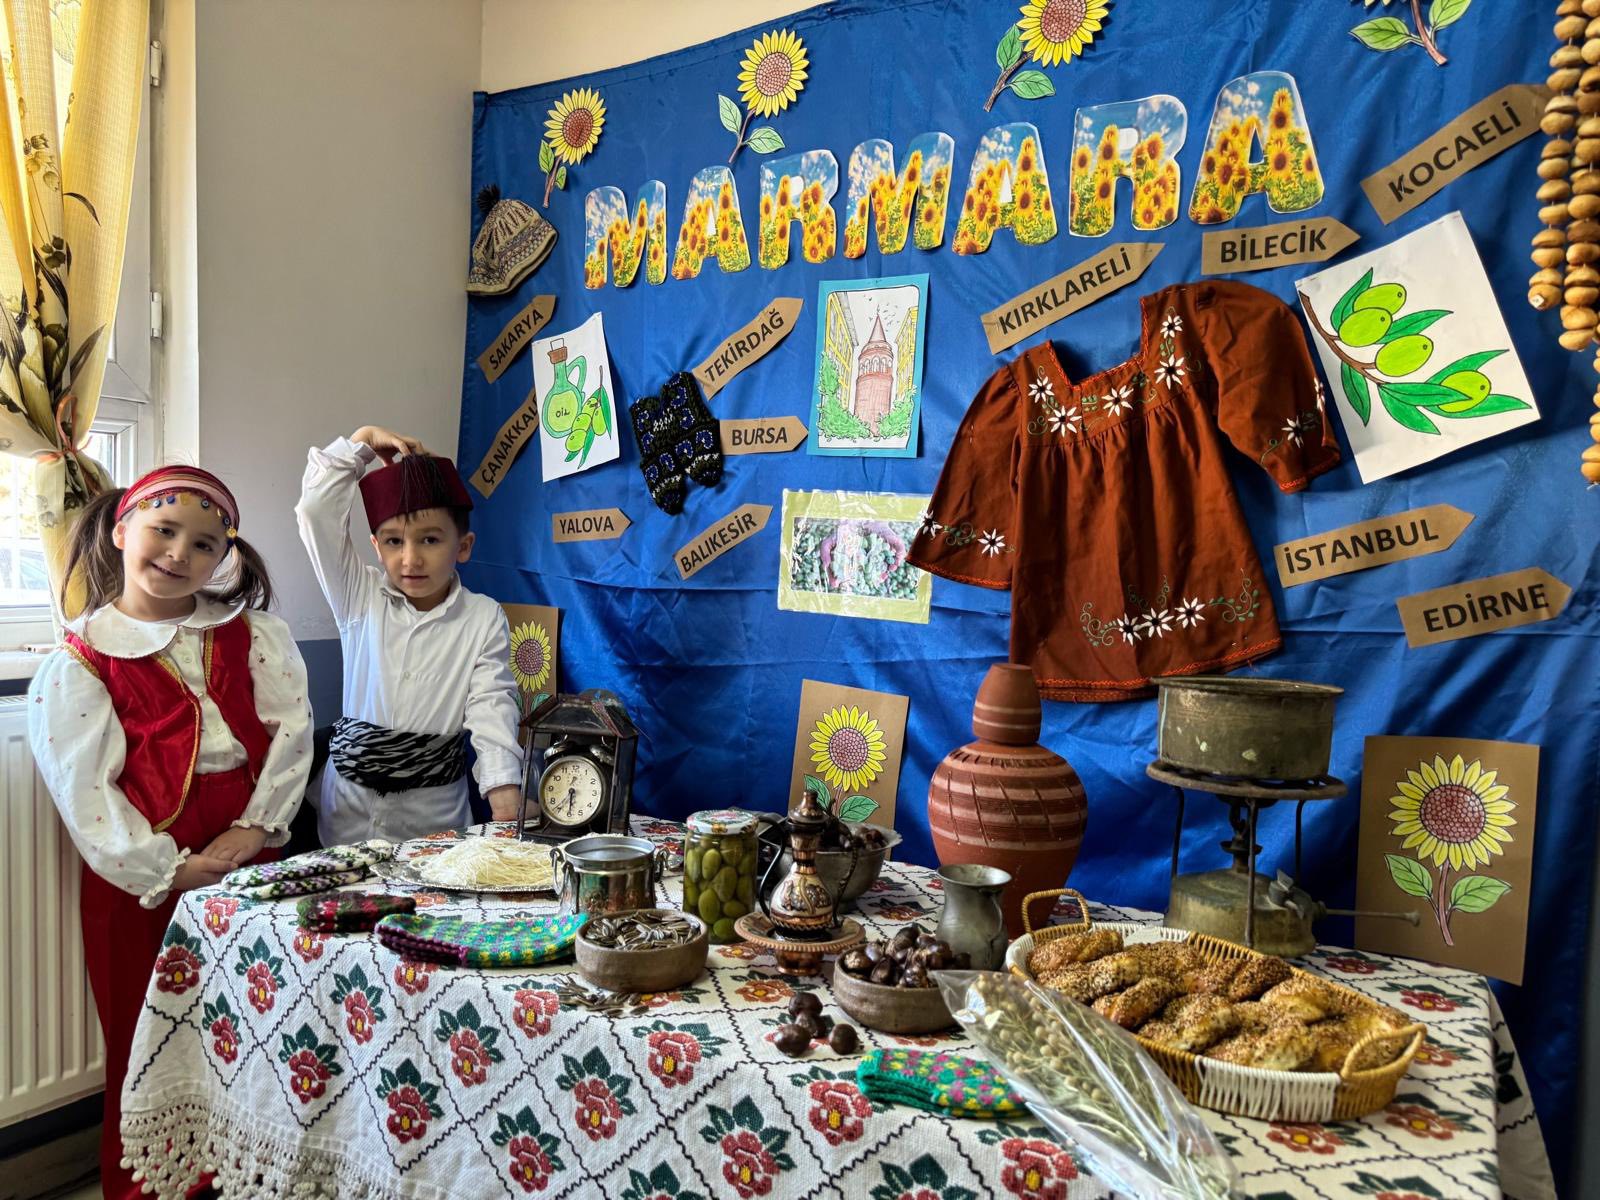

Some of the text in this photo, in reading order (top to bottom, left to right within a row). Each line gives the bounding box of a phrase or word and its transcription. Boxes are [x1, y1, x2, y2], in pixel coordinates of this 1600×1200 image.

[584, 70, 1324, 289] MARMARA
[1388, 99, 1521, 201] KOCAELİ
[1220, 219, 1328, 263] BİLECİK
[998, 249, 1133, 335] KIRKLARELİ
[489, 309, 544, 371] SAKARYA
[704, 308, 785, 384] TEKİRDAĞ
[731, 427, 788, 446] BURSA
[559, 516, 615, 535] YALOVA
[680, 511, 757, 575] BALIKESİR
[1284, 518, 1440, 574] İSTANBUL
[1422, 583, 1551, 633] EDİRNE
